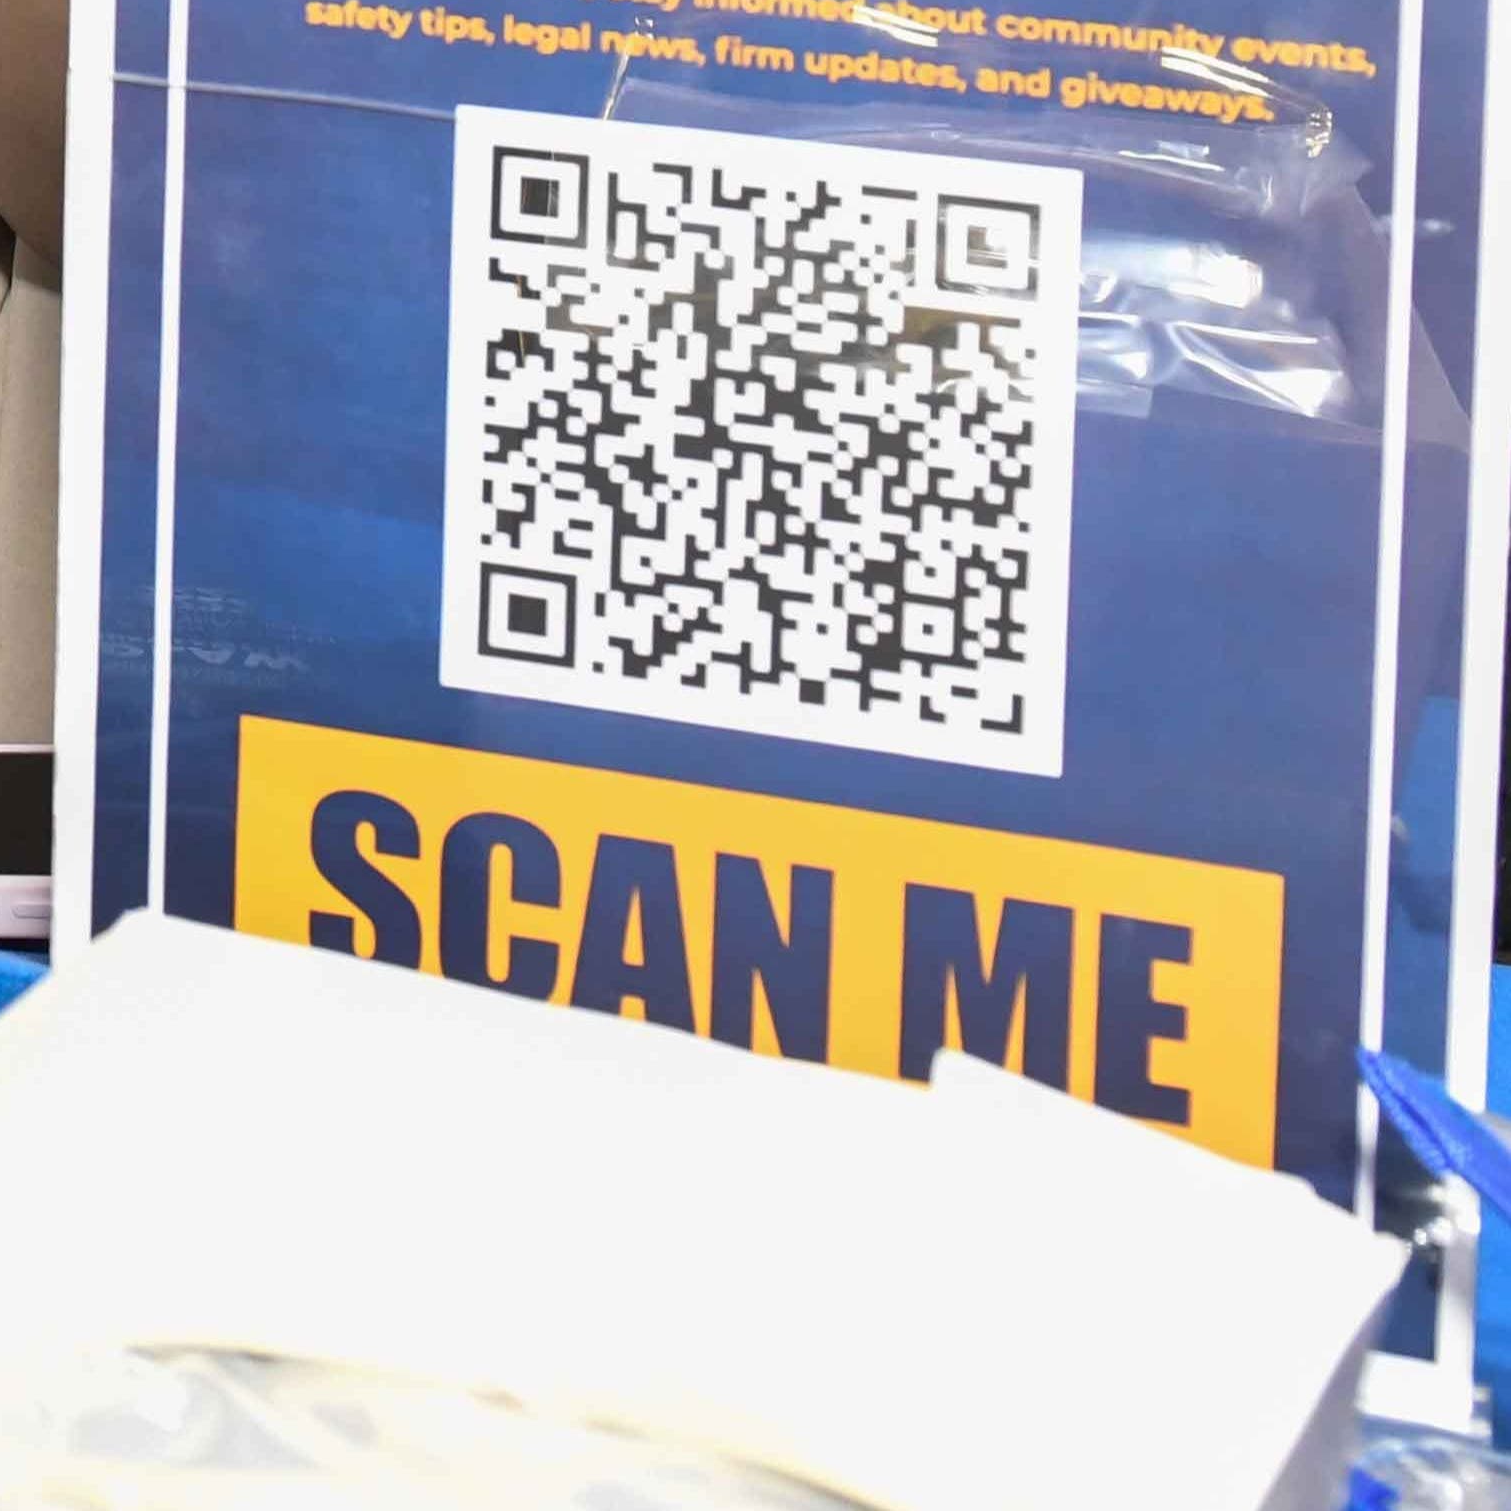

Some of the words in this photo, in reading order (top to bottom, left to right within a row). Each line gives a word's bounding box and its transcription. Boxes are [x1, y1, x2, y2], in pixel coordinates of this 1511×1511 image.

[419, 7, 495, 44] tips,
[503, 15, 592, 55] legal
[600, 31, 706, 66] news,
[714, 35, 795, 71] firm
[804, 52, 967, 93] updates,
[975, 67, 1052, 98] and
[1060, 72, 1275, 124] giveaways.
[997, 15, 1225, 59] community
[1232, 38, 1376, 77] events,
[305, 788, 838, 1069] SCAN
[898, 880, 1195, 1130] ME
